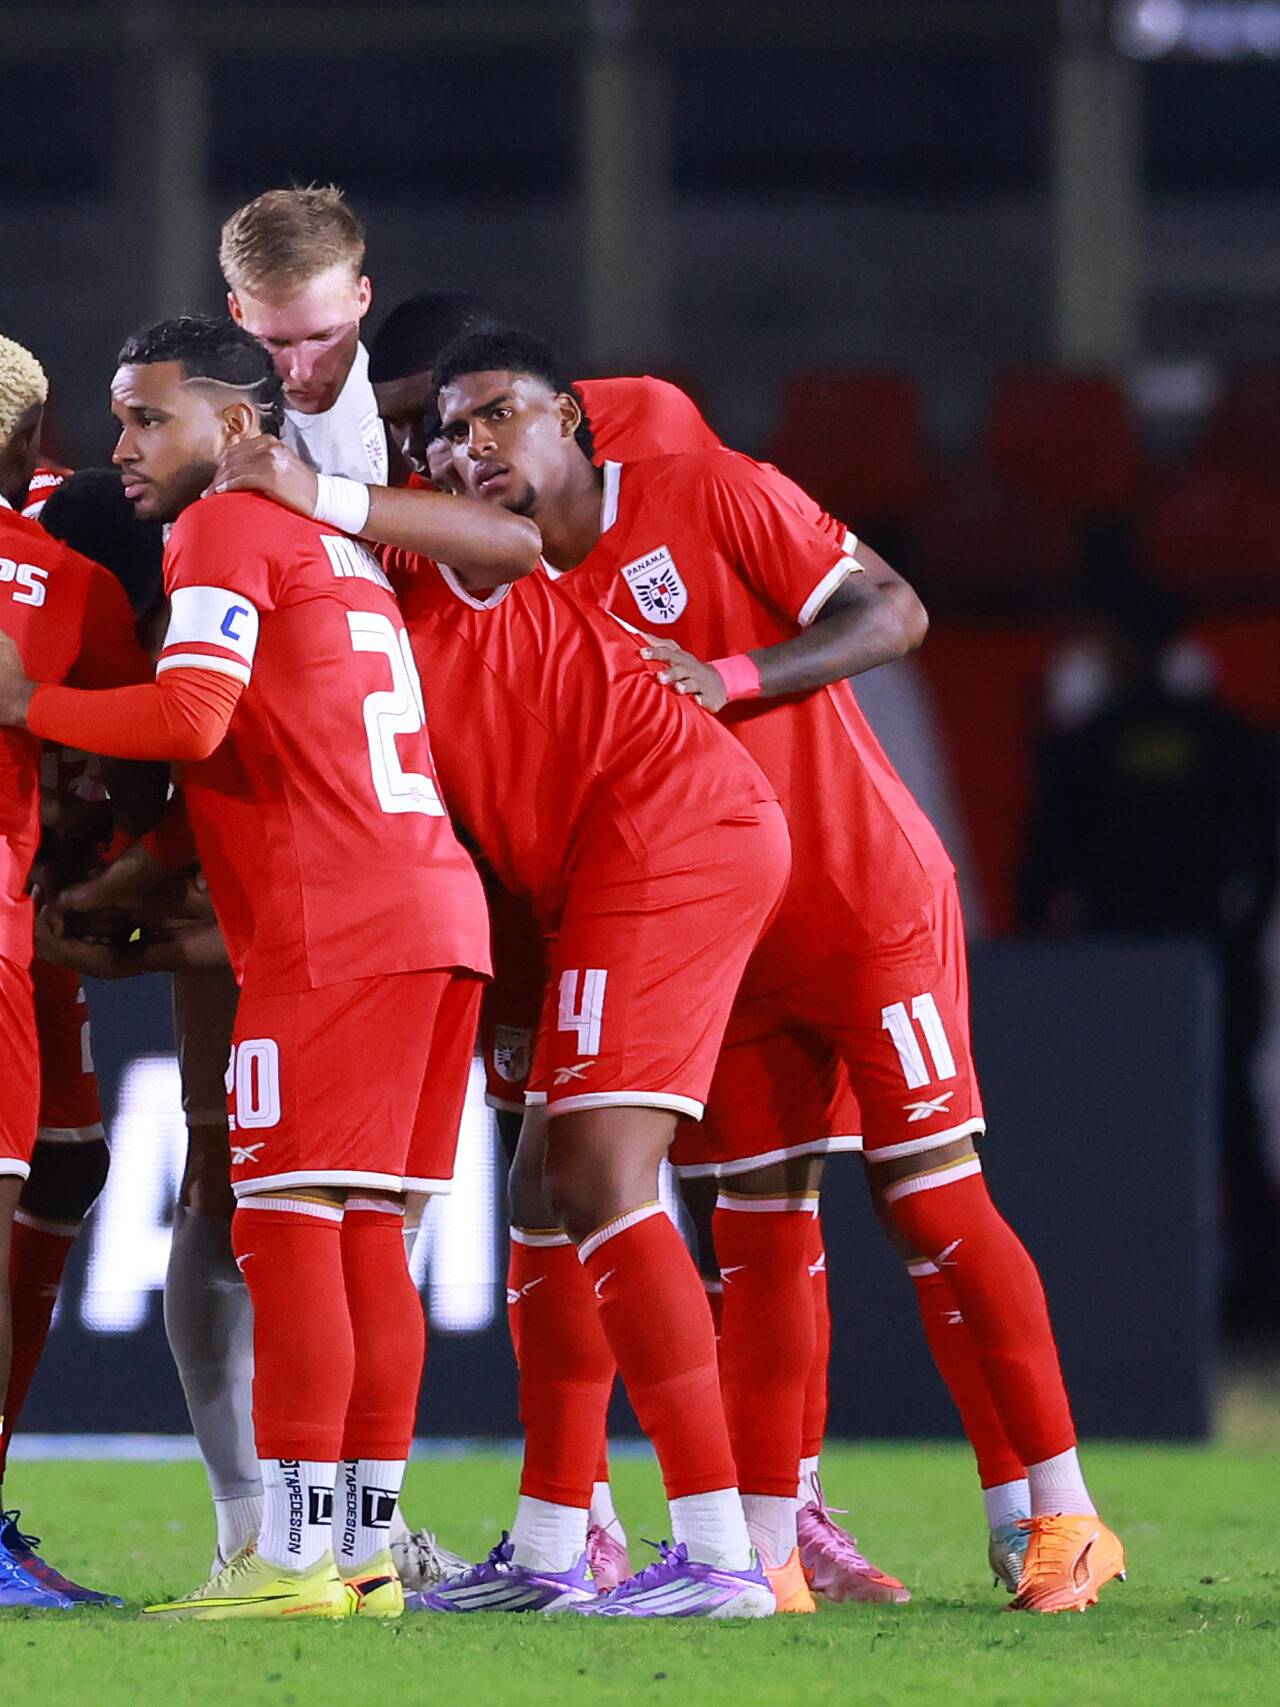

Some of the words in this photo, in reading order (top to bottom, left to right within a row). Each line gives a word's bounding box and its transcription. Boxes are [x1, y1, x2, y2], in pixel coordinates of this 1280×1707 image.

[626, 551, 666, 577] PANAMA
[220, 605, 249, 641] C
[346, 610, 446, 817] 2
[557, 968, 608, 1056] 4
[881, 993, 958, 1090] 11
[284, 1469, 303, 1555] TAPEDESIGN
[341, 1465, 358, 1557] TAPEDESIGN
